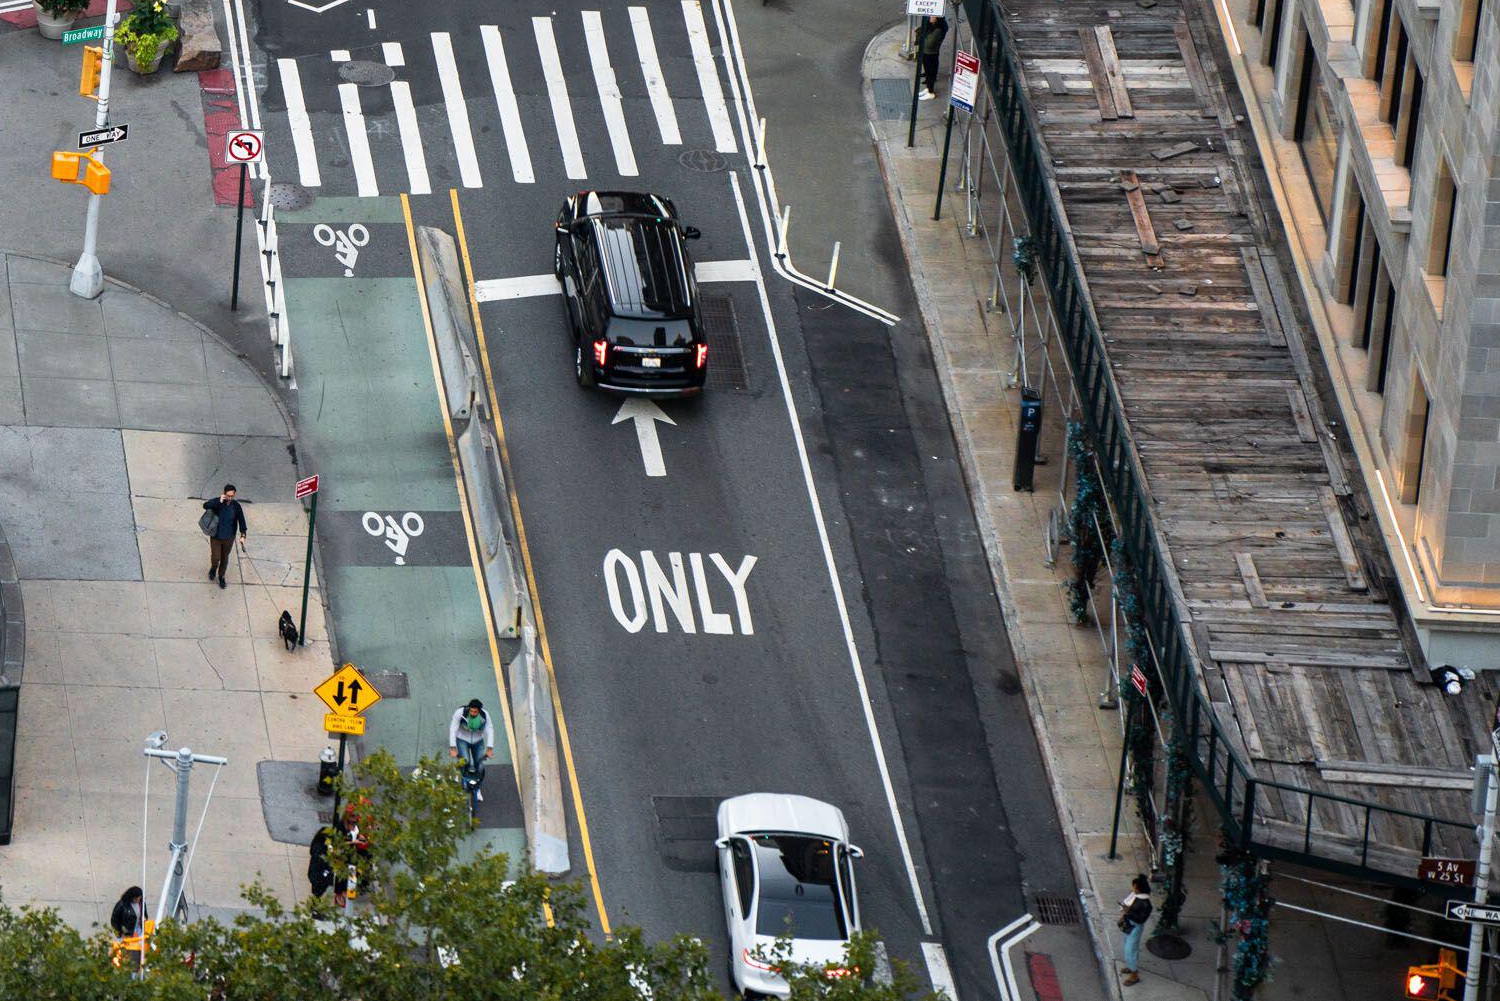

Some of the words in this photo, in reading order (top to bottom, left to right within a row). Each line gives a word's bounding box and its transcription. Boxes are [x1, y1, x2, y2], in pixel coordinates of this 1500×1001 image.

[64, 28, 103, 42] Broadway
[86, 134, 100, 144] ONE
[603, 548, 758, 635] ONLY
[1438, 862, 1443, 872] 5
[1446, 862, 1459, 872] Av
[1428, 871, 1436, 879] W
[1439, 872, 1450, 881] 25
[1454, 873, 1464, 884] St
[1457, 907, 1477, 917] ONE
[1486, 911, 1500, 920] WA
